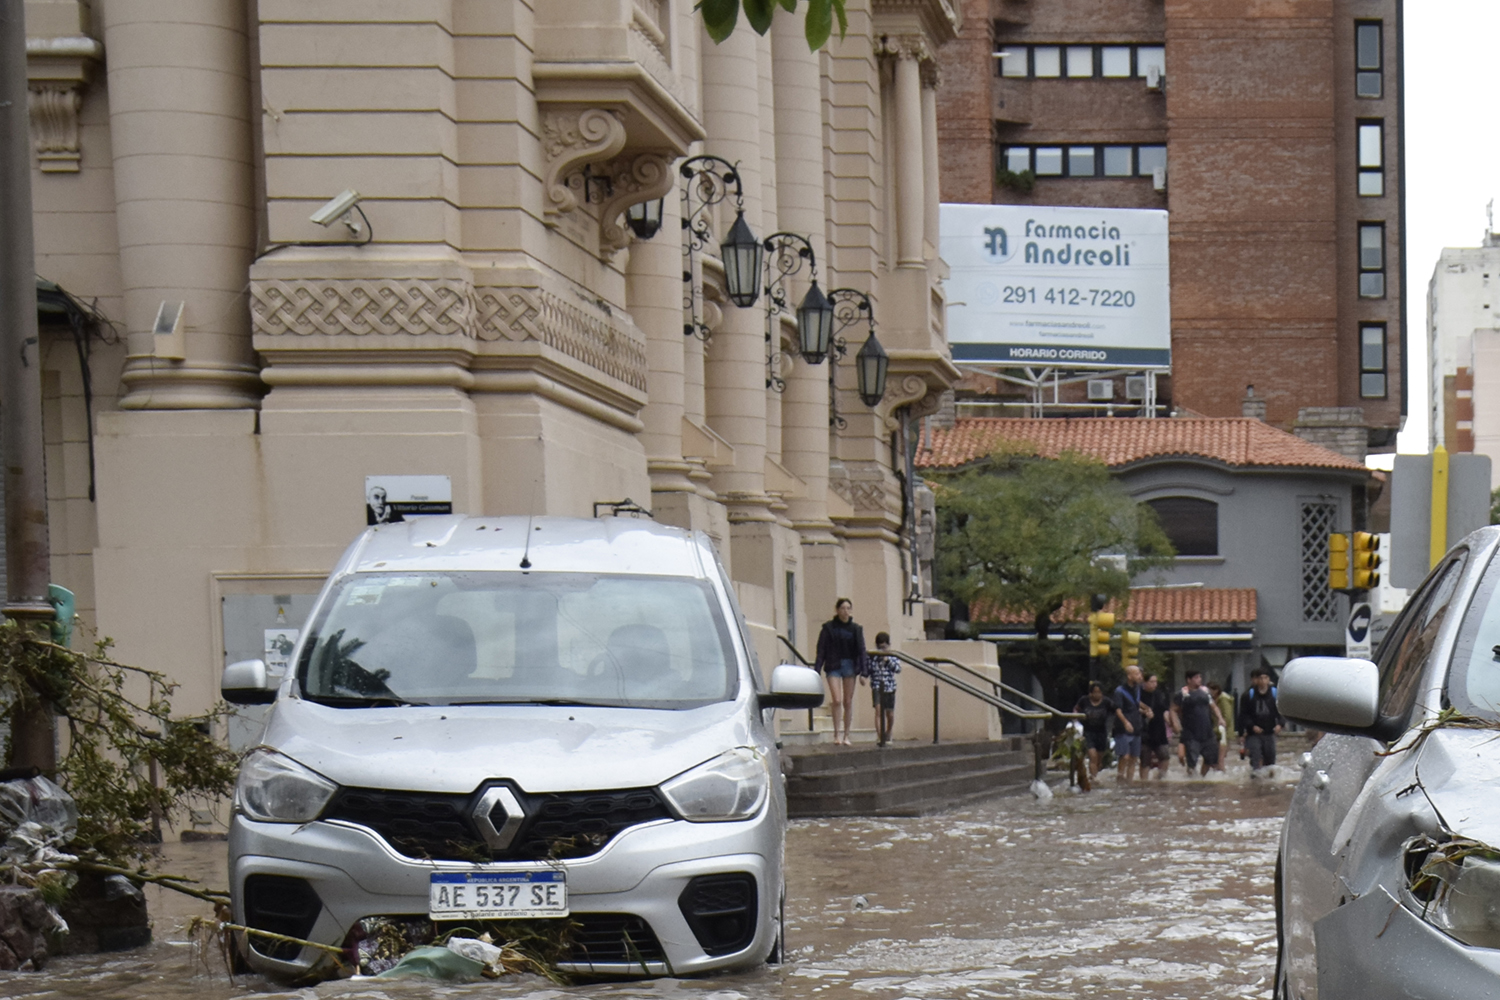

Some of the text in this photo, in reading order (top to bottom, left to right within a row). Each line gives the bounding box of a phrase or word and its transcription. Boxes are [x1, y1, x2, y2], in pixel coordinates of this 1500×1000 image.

[1024, 218, 1121, 240] Farmacia
[1024, 241, 1130, 266] Andreoli
[1003, 285, 1136, 308] 291 412-7220
[1009, 347, 1107, 360] HORARIO CORRIDO
[438, 884, 560, 907] AE 537 SE
